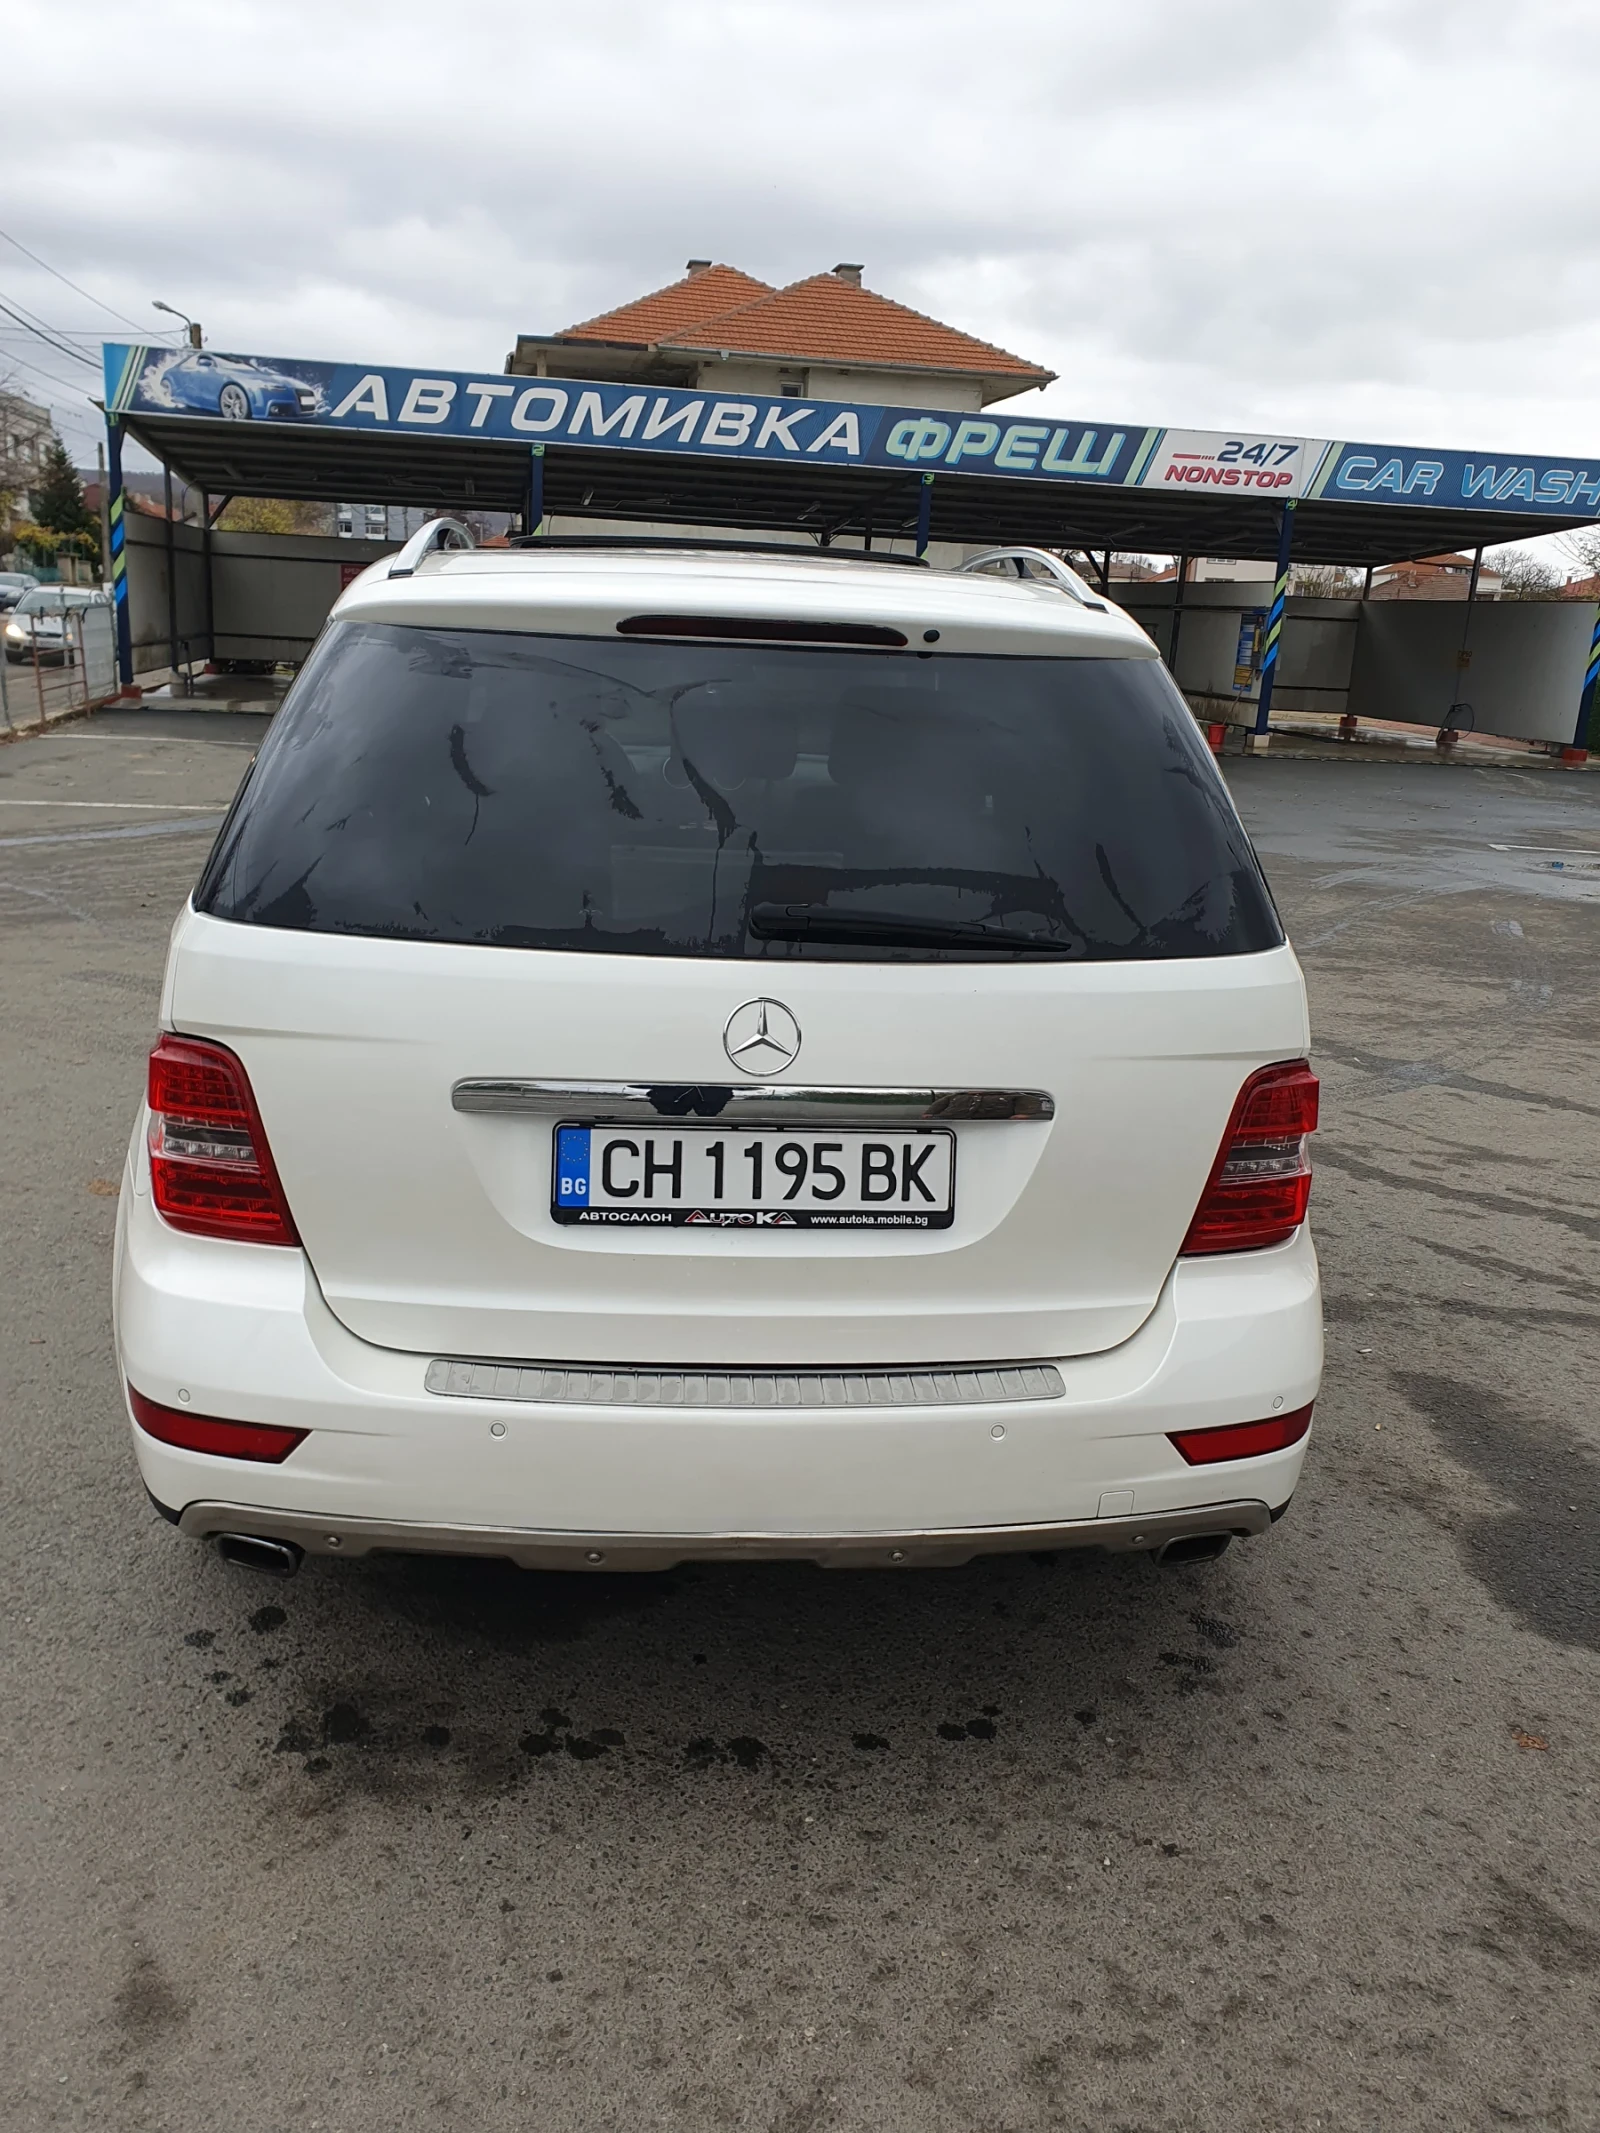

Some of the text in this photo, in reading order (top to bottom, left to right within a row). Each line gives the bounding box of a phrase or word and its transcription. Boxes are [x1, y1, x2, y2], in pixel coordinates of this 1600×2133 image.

[330, 374, 1128, 478] АВТОМИВКА ФРЕШ
[1217, 441, 1299, 467] 24/7
[1164, 465, 1293, 488] NONSTOP
[1335, 456, 1600, 505] CAR WASH
[705, 1141, 846, 1200] 1195
[561, 1178, 587, 1195] BG
[579, 1212, 672, 1222] АВТОСАЛОН
[810, 1214, 929, 1226] www.autoka.mobile.bg
